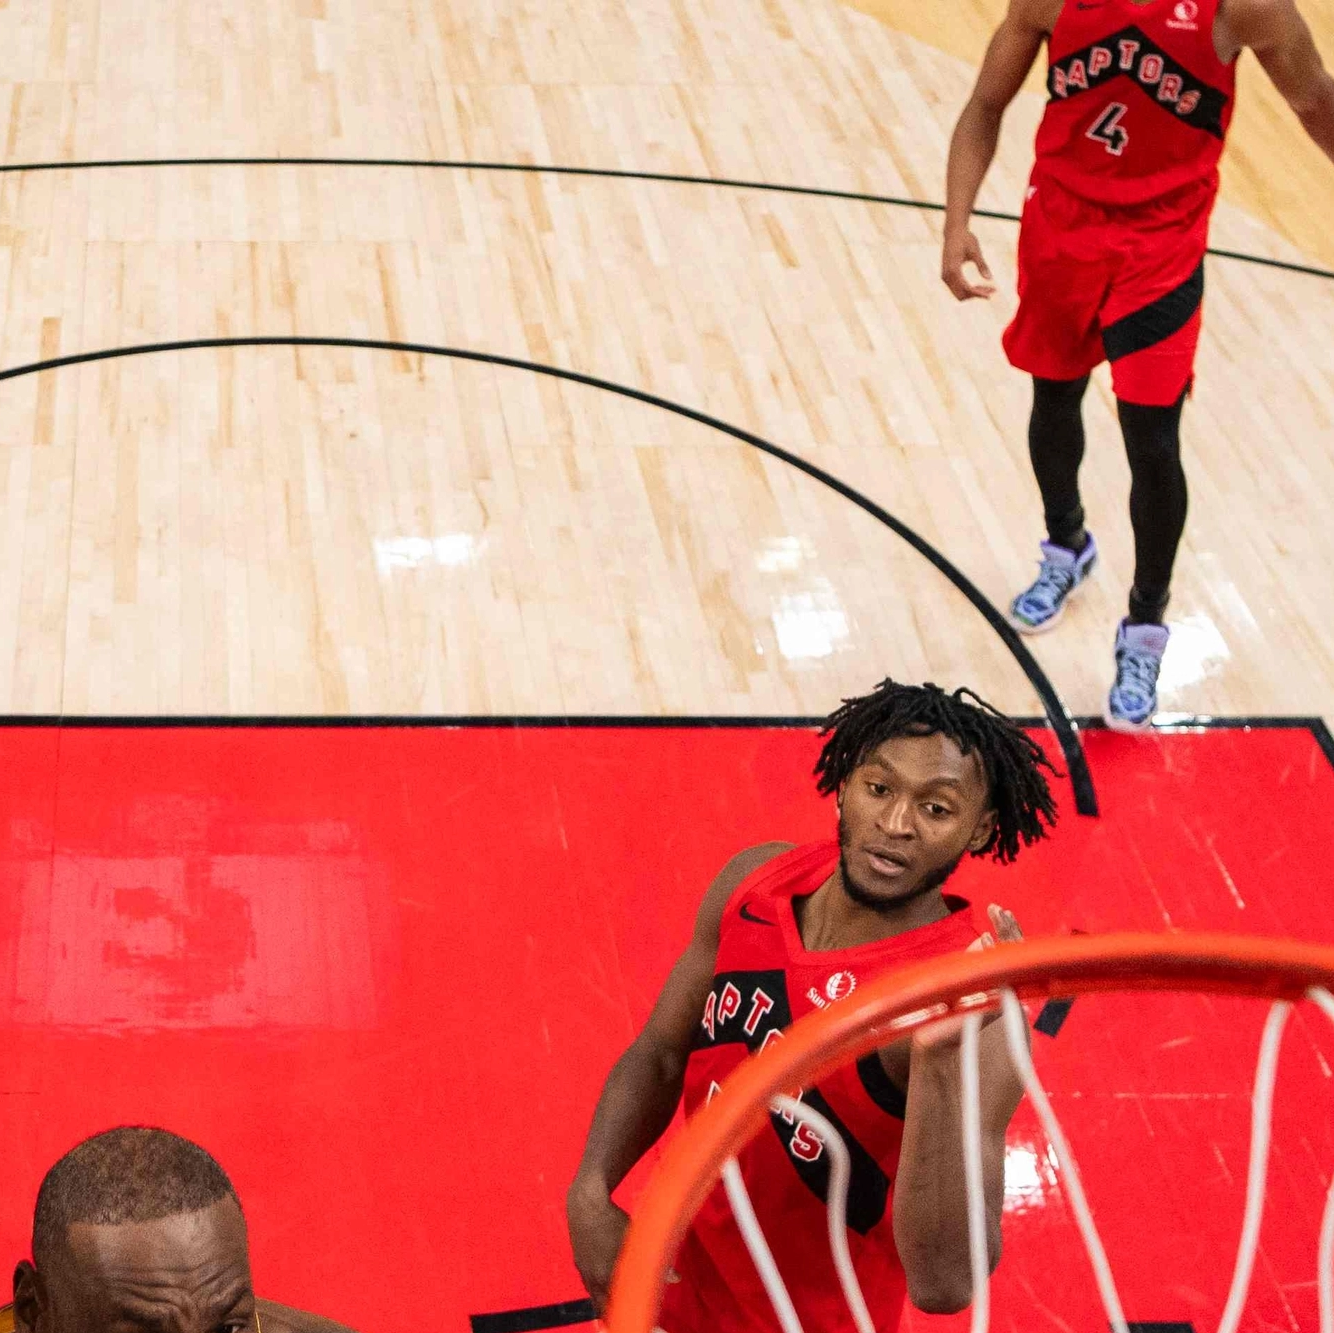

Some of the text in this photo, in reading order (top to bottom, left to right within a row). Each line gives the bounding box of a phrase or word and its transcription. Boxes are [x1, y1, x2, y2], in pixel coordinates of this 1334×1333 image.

[1053, 39, 1201, 116] RAPTORS
[1085, 102, 1129, 156] 4
[806, 987, 826, 1009] Sun
